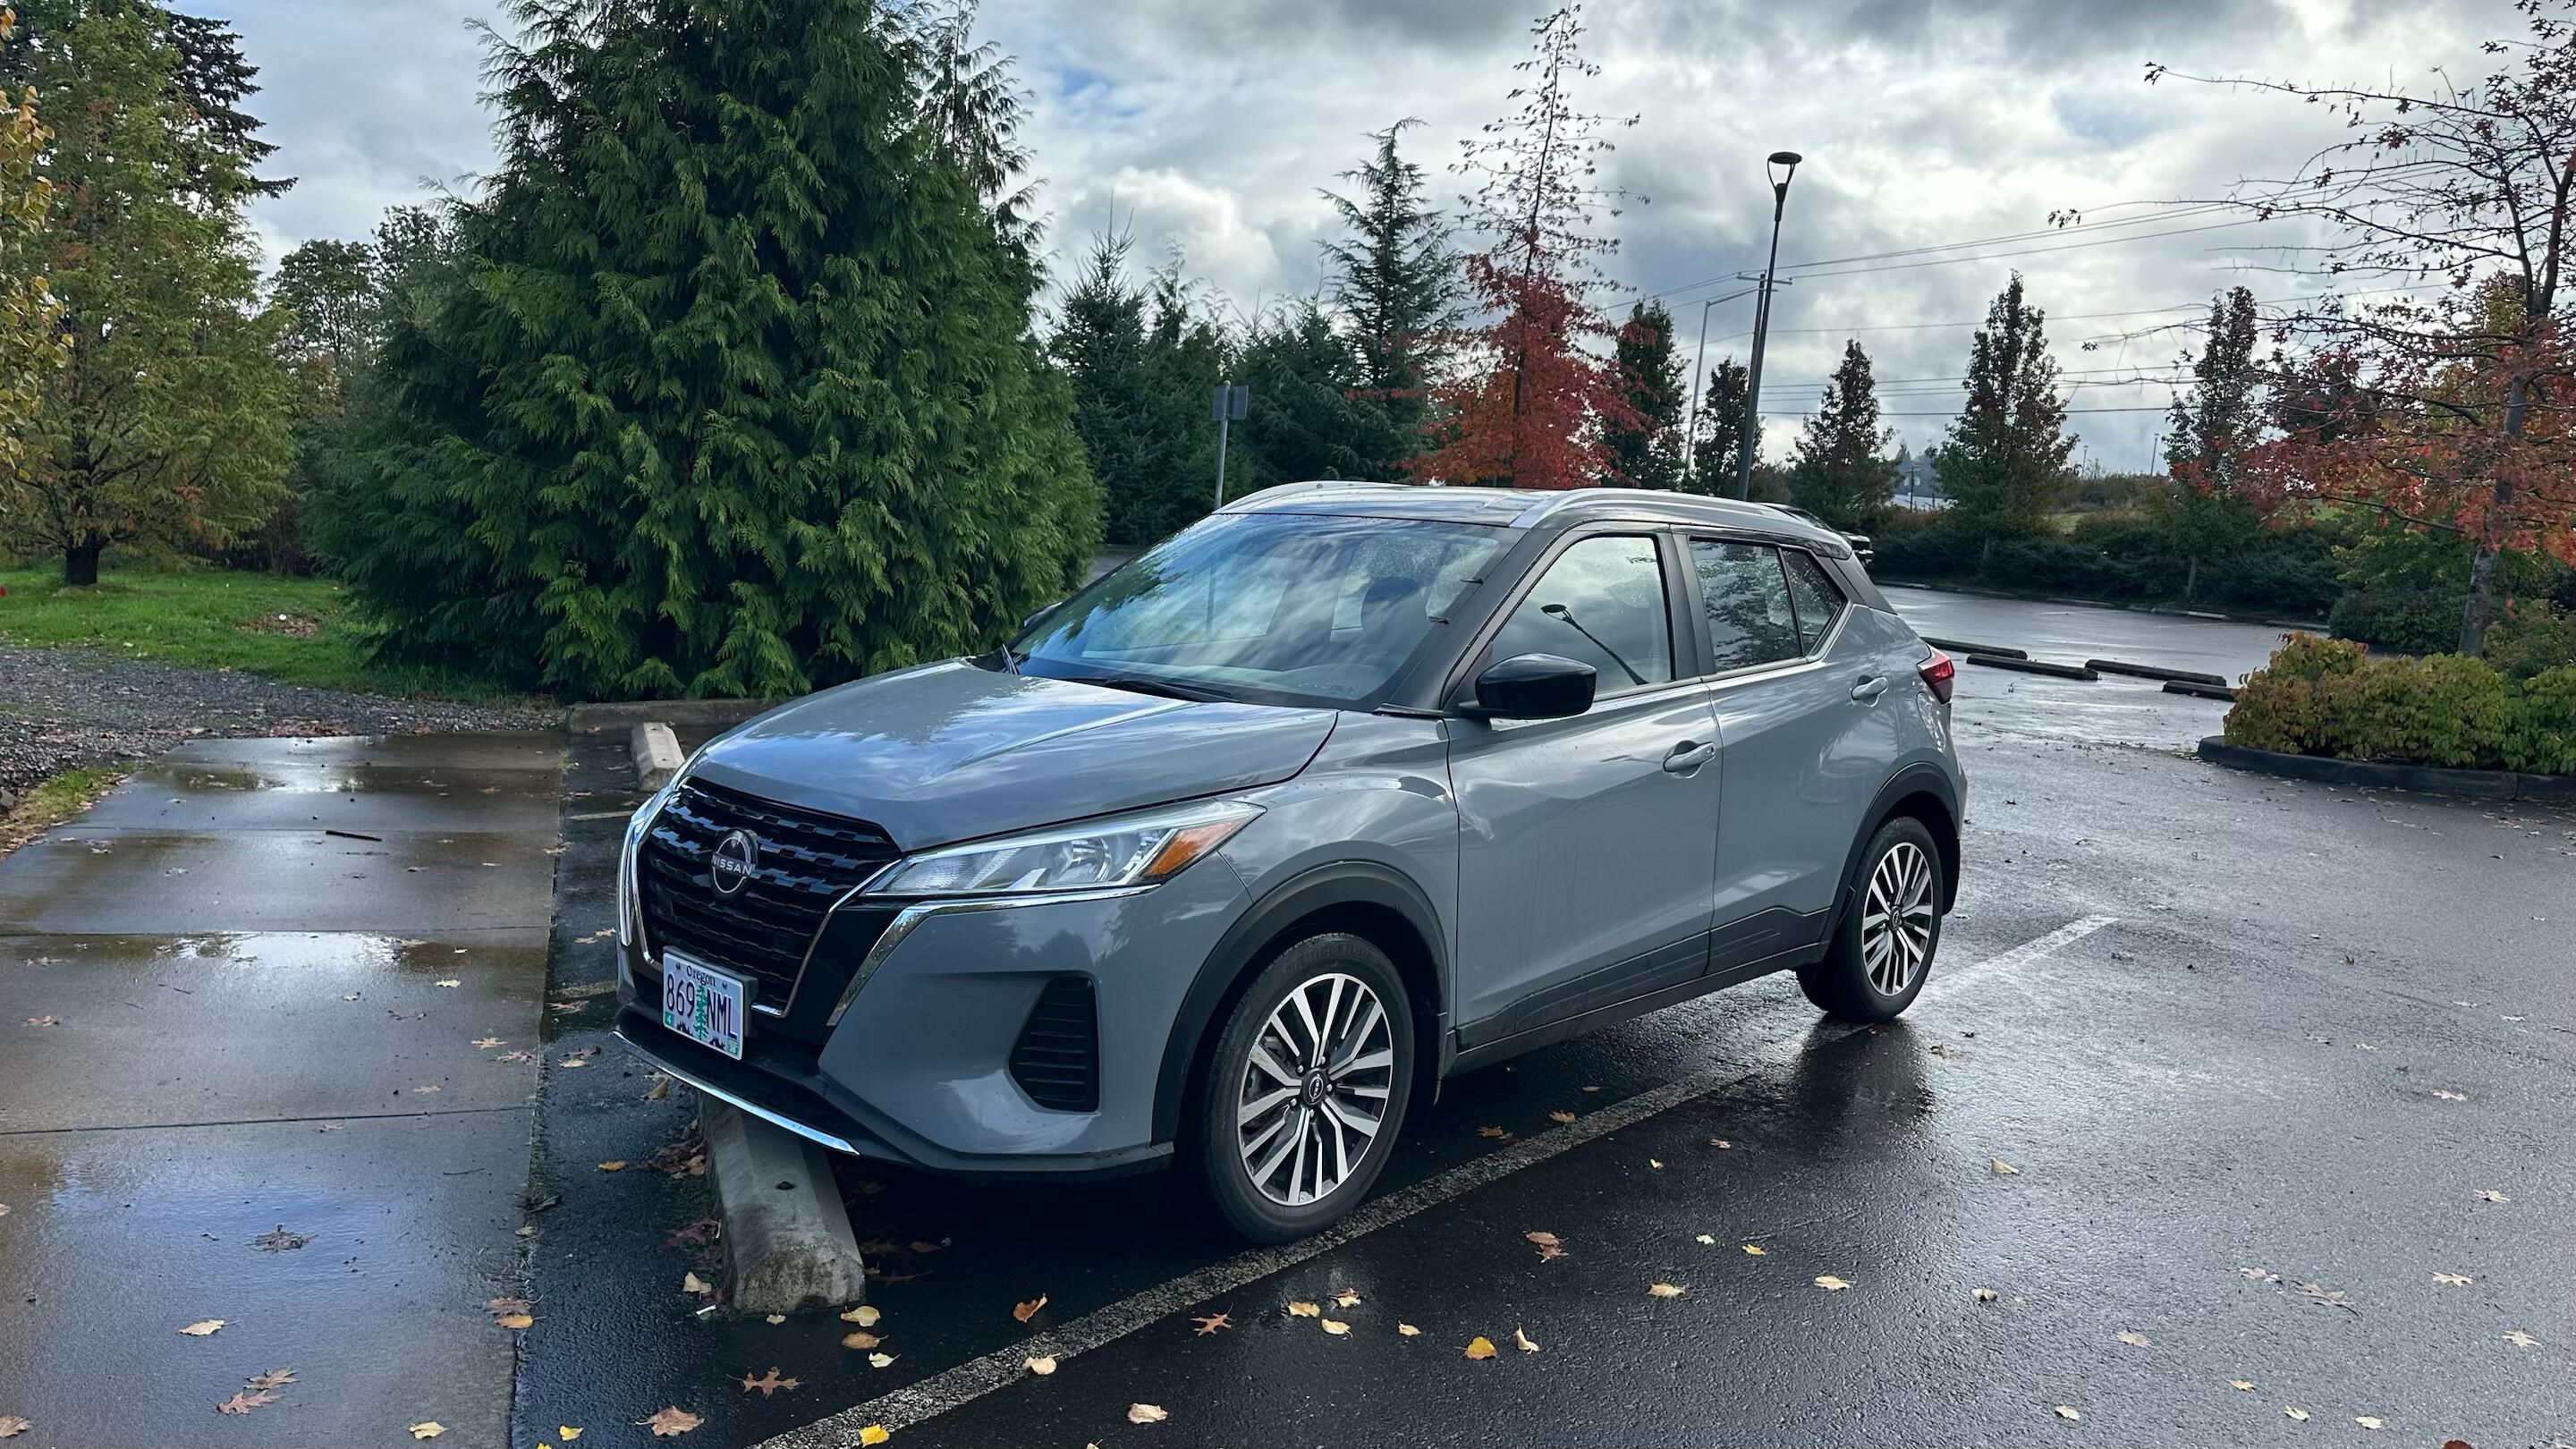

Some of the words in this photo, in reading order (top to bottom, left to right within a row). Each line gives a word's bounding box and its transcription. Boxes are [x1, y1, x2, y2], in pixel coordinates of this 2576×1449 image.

[712, 855, 752, 876] NISSAN
[687, 965, 716, 986] Oregon
[667, 973, 695, 1018] 869
[707, 988, 737, 1039] NML
